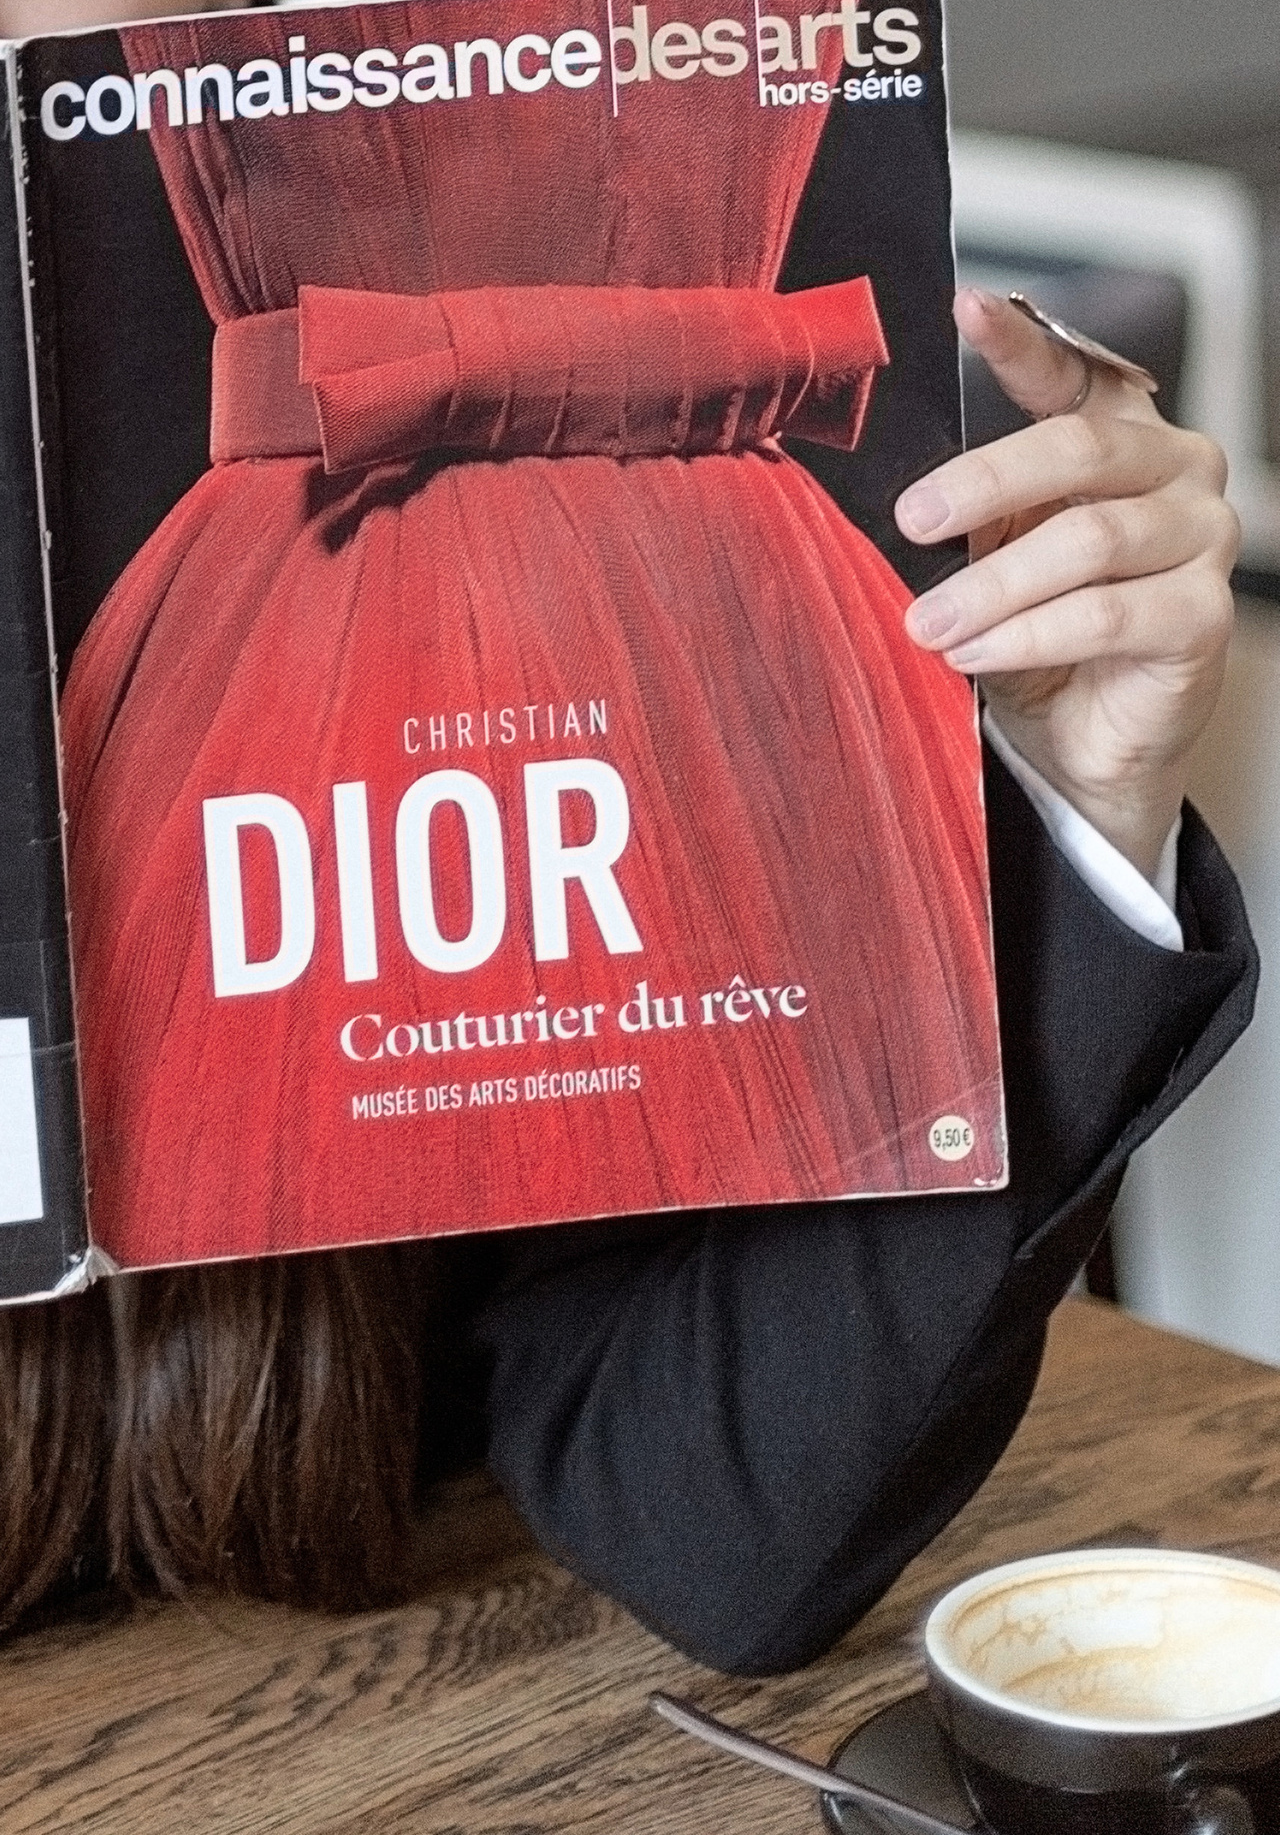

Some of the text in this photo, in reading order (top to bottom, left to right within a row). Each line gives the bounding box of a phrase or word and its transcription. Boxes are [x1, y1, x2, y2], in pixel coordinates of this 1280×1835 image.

[40, 29, 601, 141] connaissance
[612, 5, 749, 84] des
[760, 68, 922, 107] hors-série
[403, 700, 608, 754] CHRISTIAN
[202, 758, 643, 998] DIOR
[340, 974, 807, 1062] Couturier du rêve
[352, 1065, 641, 1120] MUSÉE DES ARTS DÉCORATIFS
